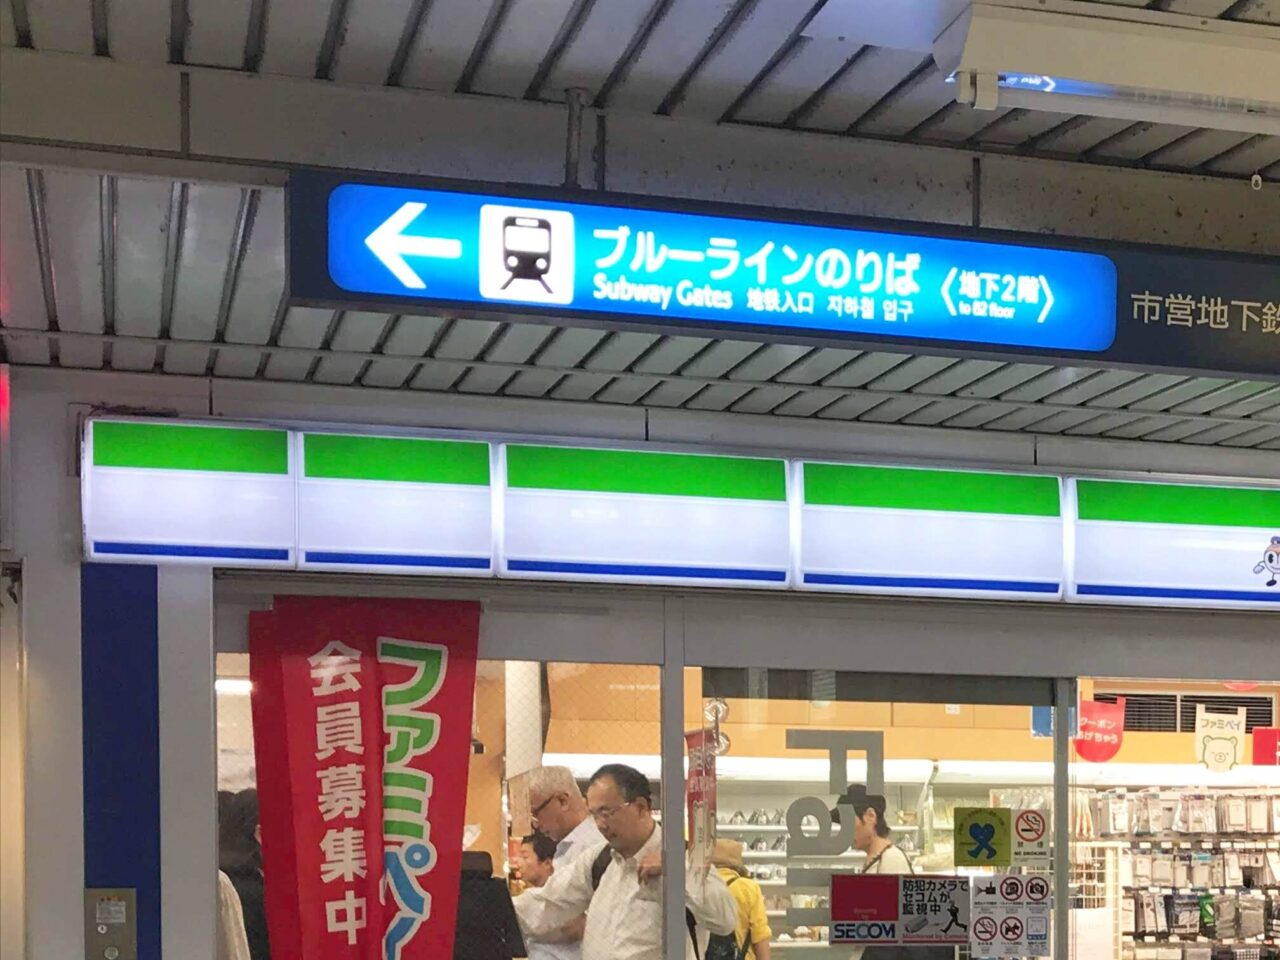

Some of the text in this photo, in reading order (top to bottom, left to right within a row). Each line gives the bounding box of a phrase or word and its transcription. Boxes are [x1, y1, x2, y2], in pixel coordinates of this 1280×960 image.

[593, 225, 920, 296] ブルーラインのりば
[593, 272, 733, 311] Subway Gates
[882, 299, 914, 322] 입구
[1200, 717, 1243, 731] ファミペイ
[307, 640, 368, 945] 会員募集中
[902, 879, 969, 892] 防犯カメラで
[902, 891, 951, 904] セコムが
[902, 903, 941, 916] 監視中
[834, 923, 896, 939] SECOM
